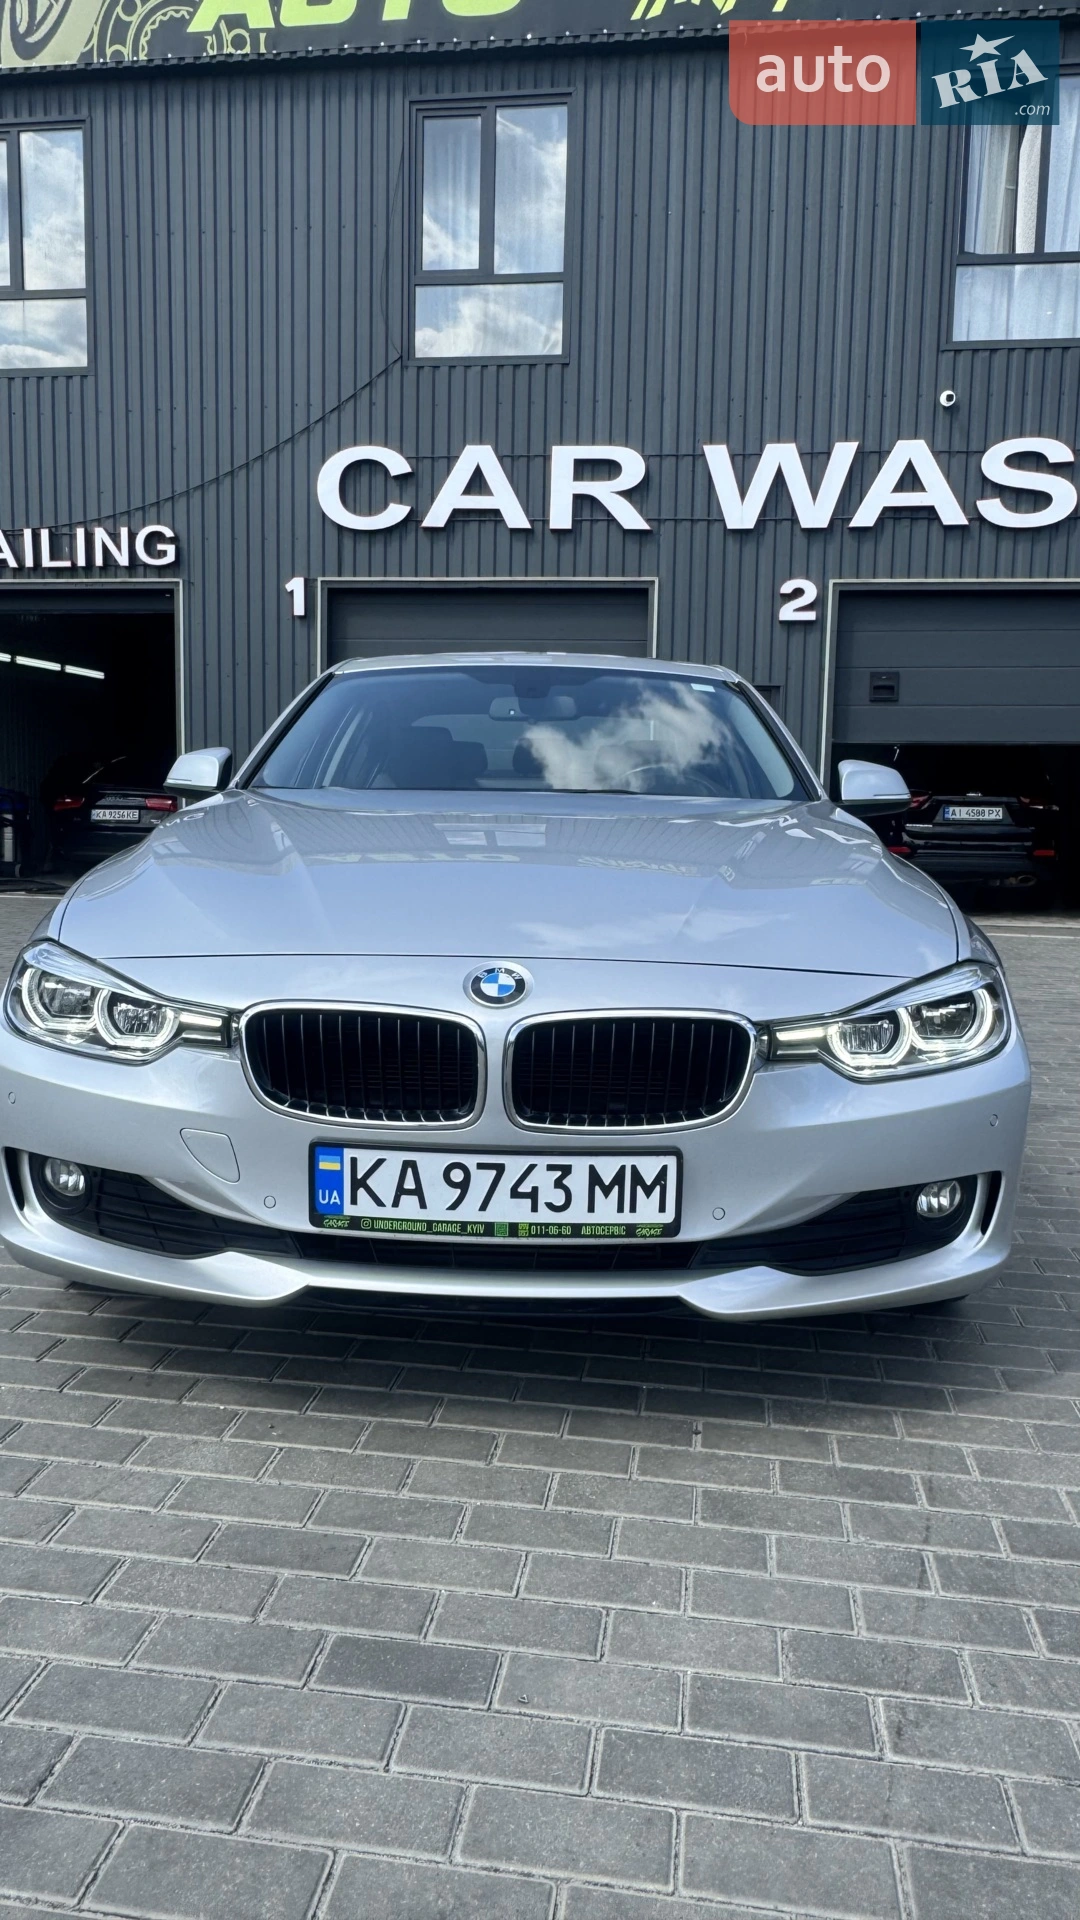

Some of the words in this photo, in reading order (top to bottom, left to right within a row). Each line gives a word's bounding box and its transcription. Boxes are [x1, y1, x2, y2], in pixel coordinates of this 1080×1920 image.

[317, 444, 652, 531] CAR
[702, 437, 1078, 530] WAS
[285, 577, 305, 616] 1
[779, 579, 818, 621] 2
[477, 967, 523, 980] BMW
[319, 1189, 341, 1205] UA
[350, 1156, 427, 1210] KA
[442, 1161, 573, 1213] 9743
[587, 1164, 668, 1213] MM
